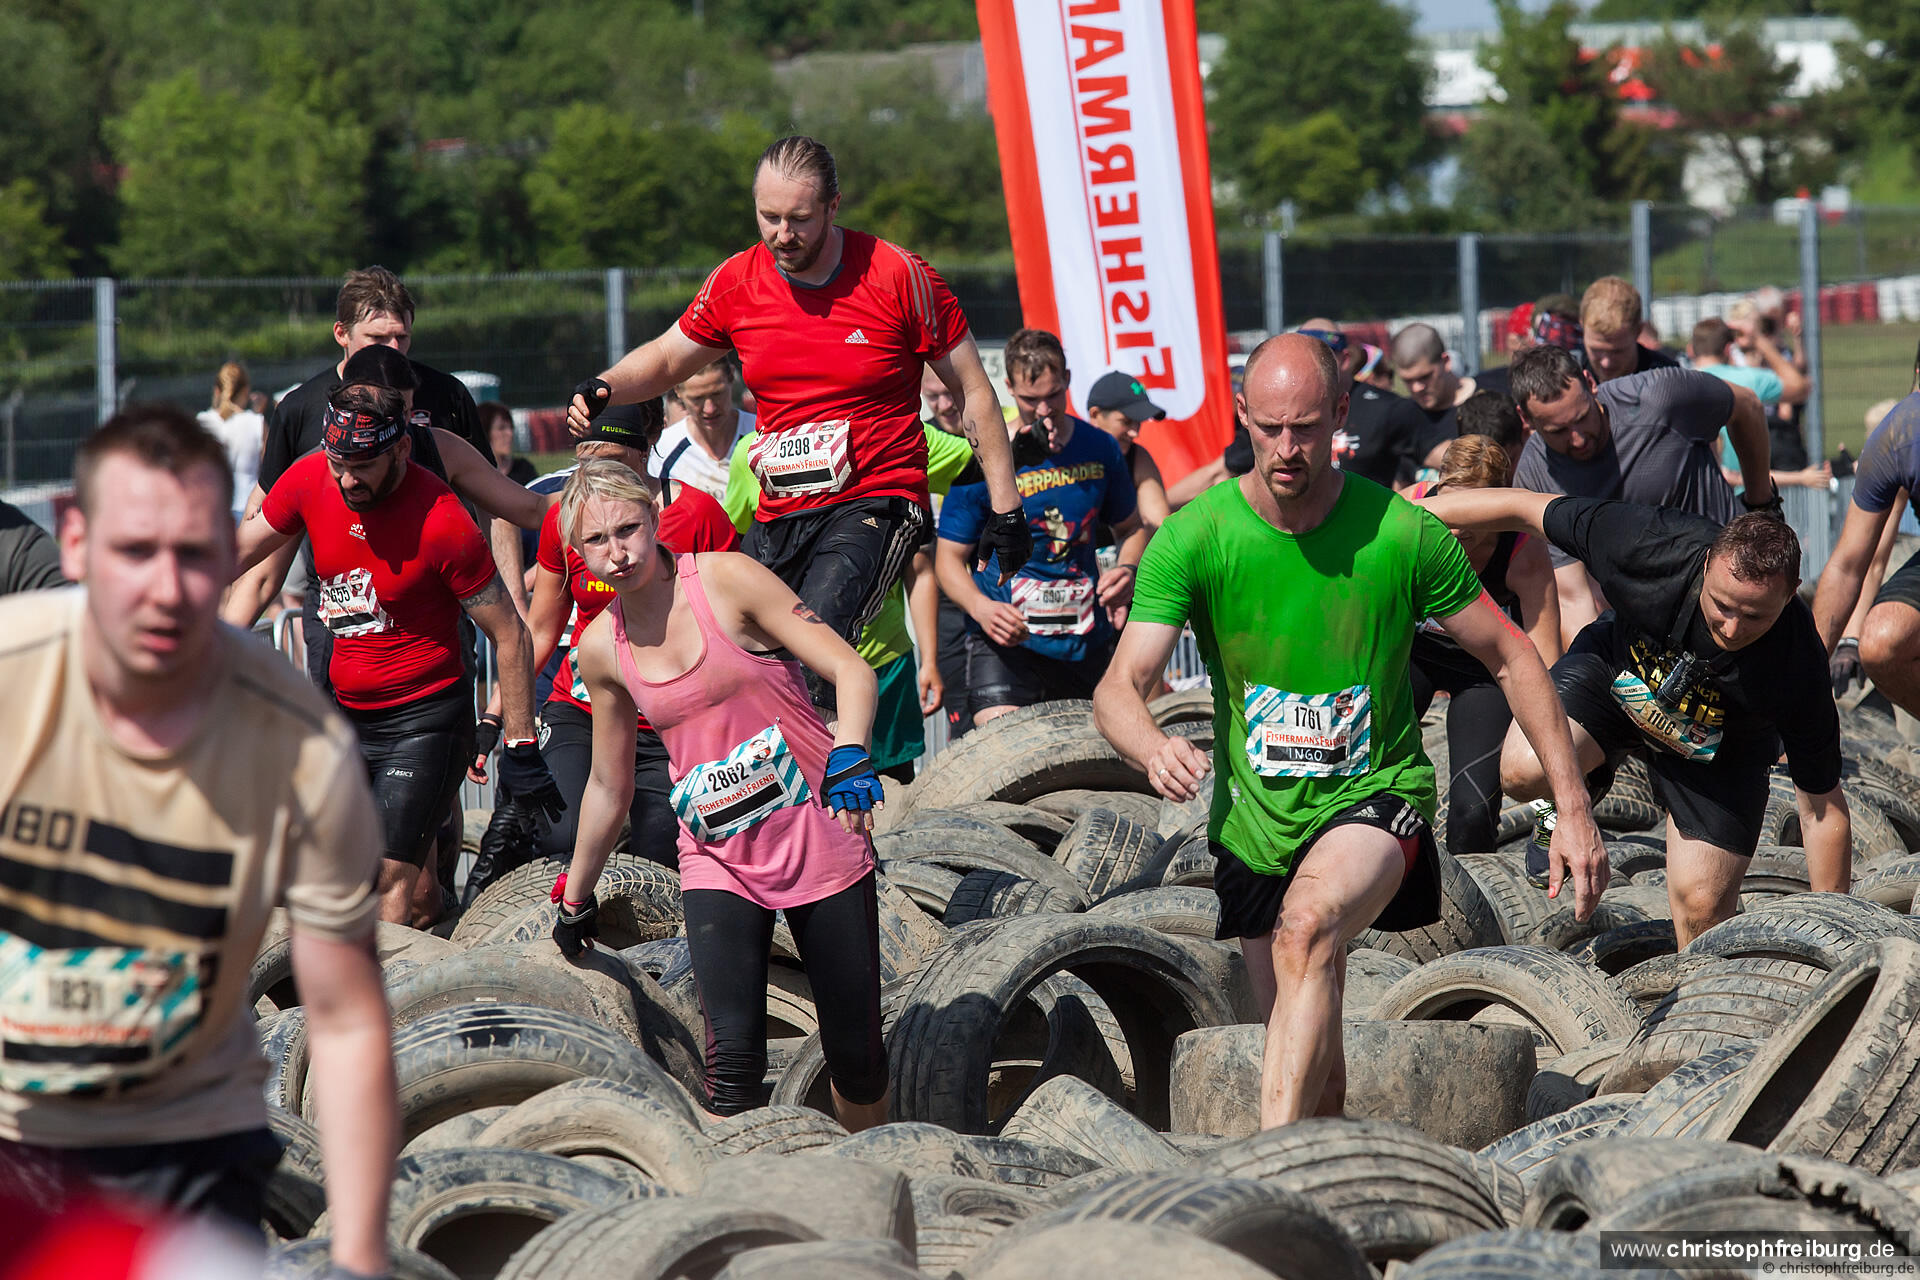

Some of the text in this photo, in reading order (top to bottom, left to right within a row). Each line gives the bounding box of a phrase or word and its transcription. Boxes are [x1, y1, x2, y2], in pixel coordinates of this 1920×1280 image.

[779, 436, 810, 459] 5298
[804, 458, 829, 470] FRIEND
[1294, 705, 1322, 731] 1761
[1265, 730, 1320, 746] FISHERMAN'S
[1288, 749, 1323, 761] INGO
[707, 761, 750, 793] 2862
[697, 773, 775, 815] FISHERMAN'S FRIEND
